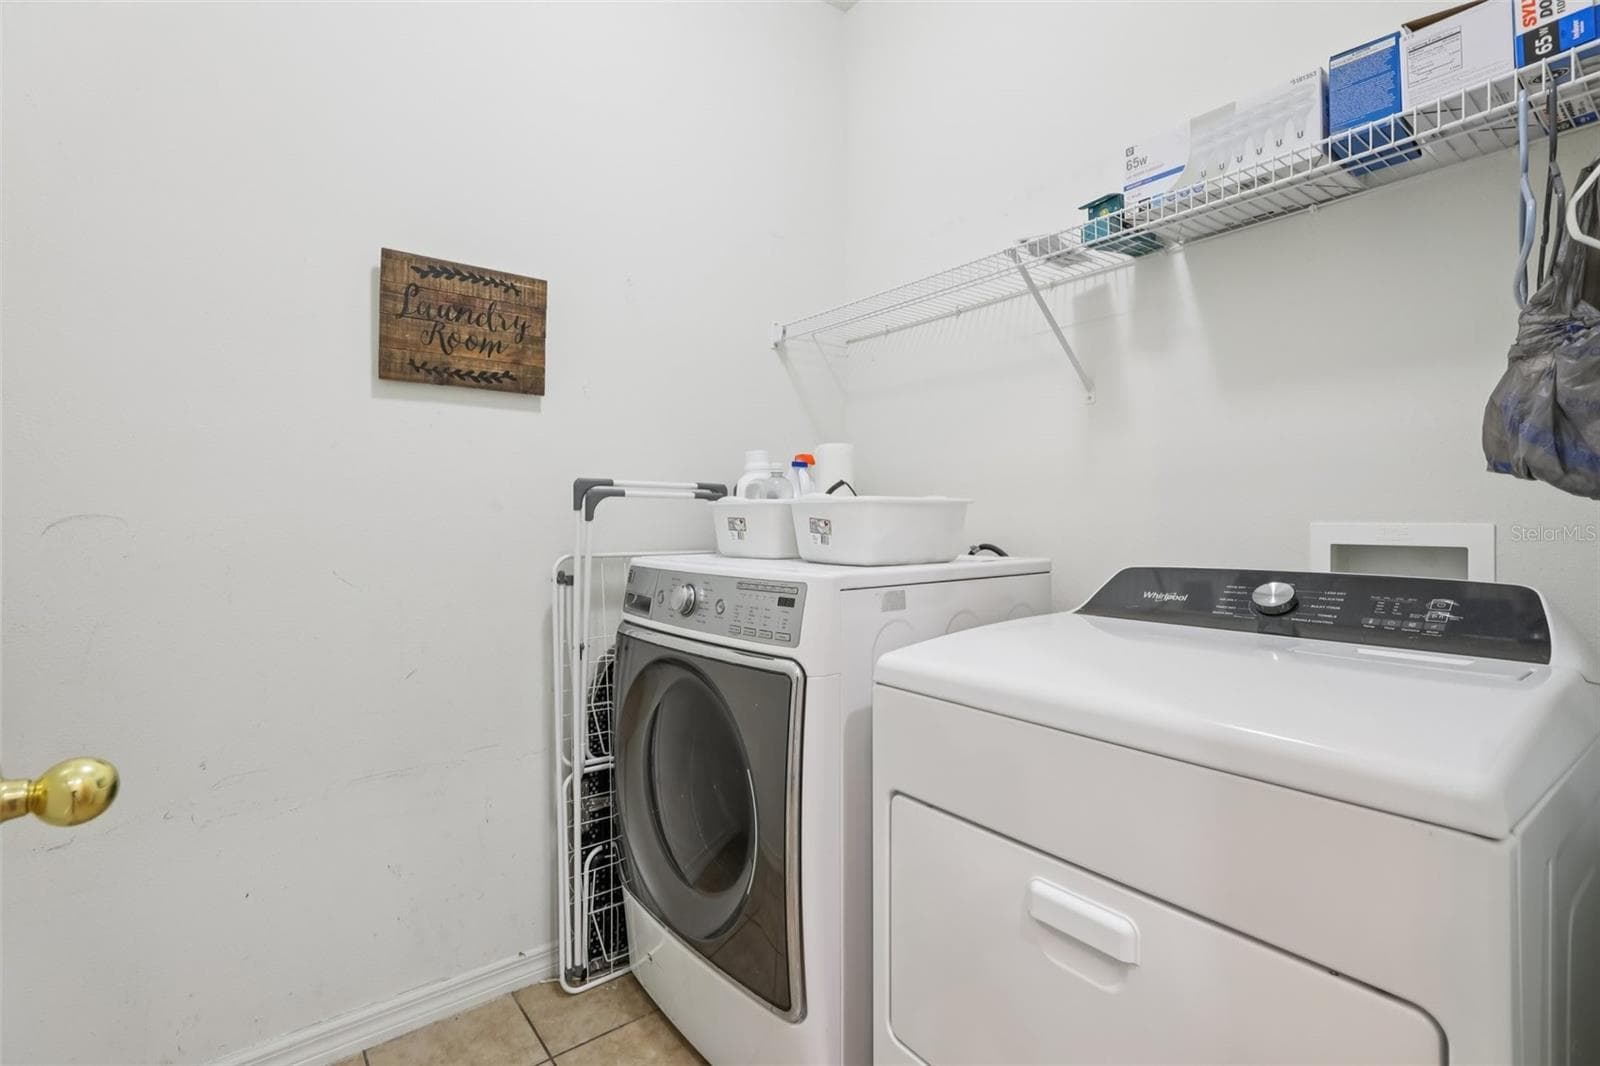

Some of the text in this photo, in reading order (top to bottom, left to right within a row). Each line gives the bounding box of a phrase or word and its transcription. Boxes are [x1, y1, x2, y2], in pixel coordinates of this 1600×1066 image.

[1521, 0, 1537, 28] SYL
[1556, 0, 1566, 14] FLO
[395, 282, 531, 344] Laundry
[420, 321, 509, 358] Room
[1143, 591, 1188, 602] Whirlpool
